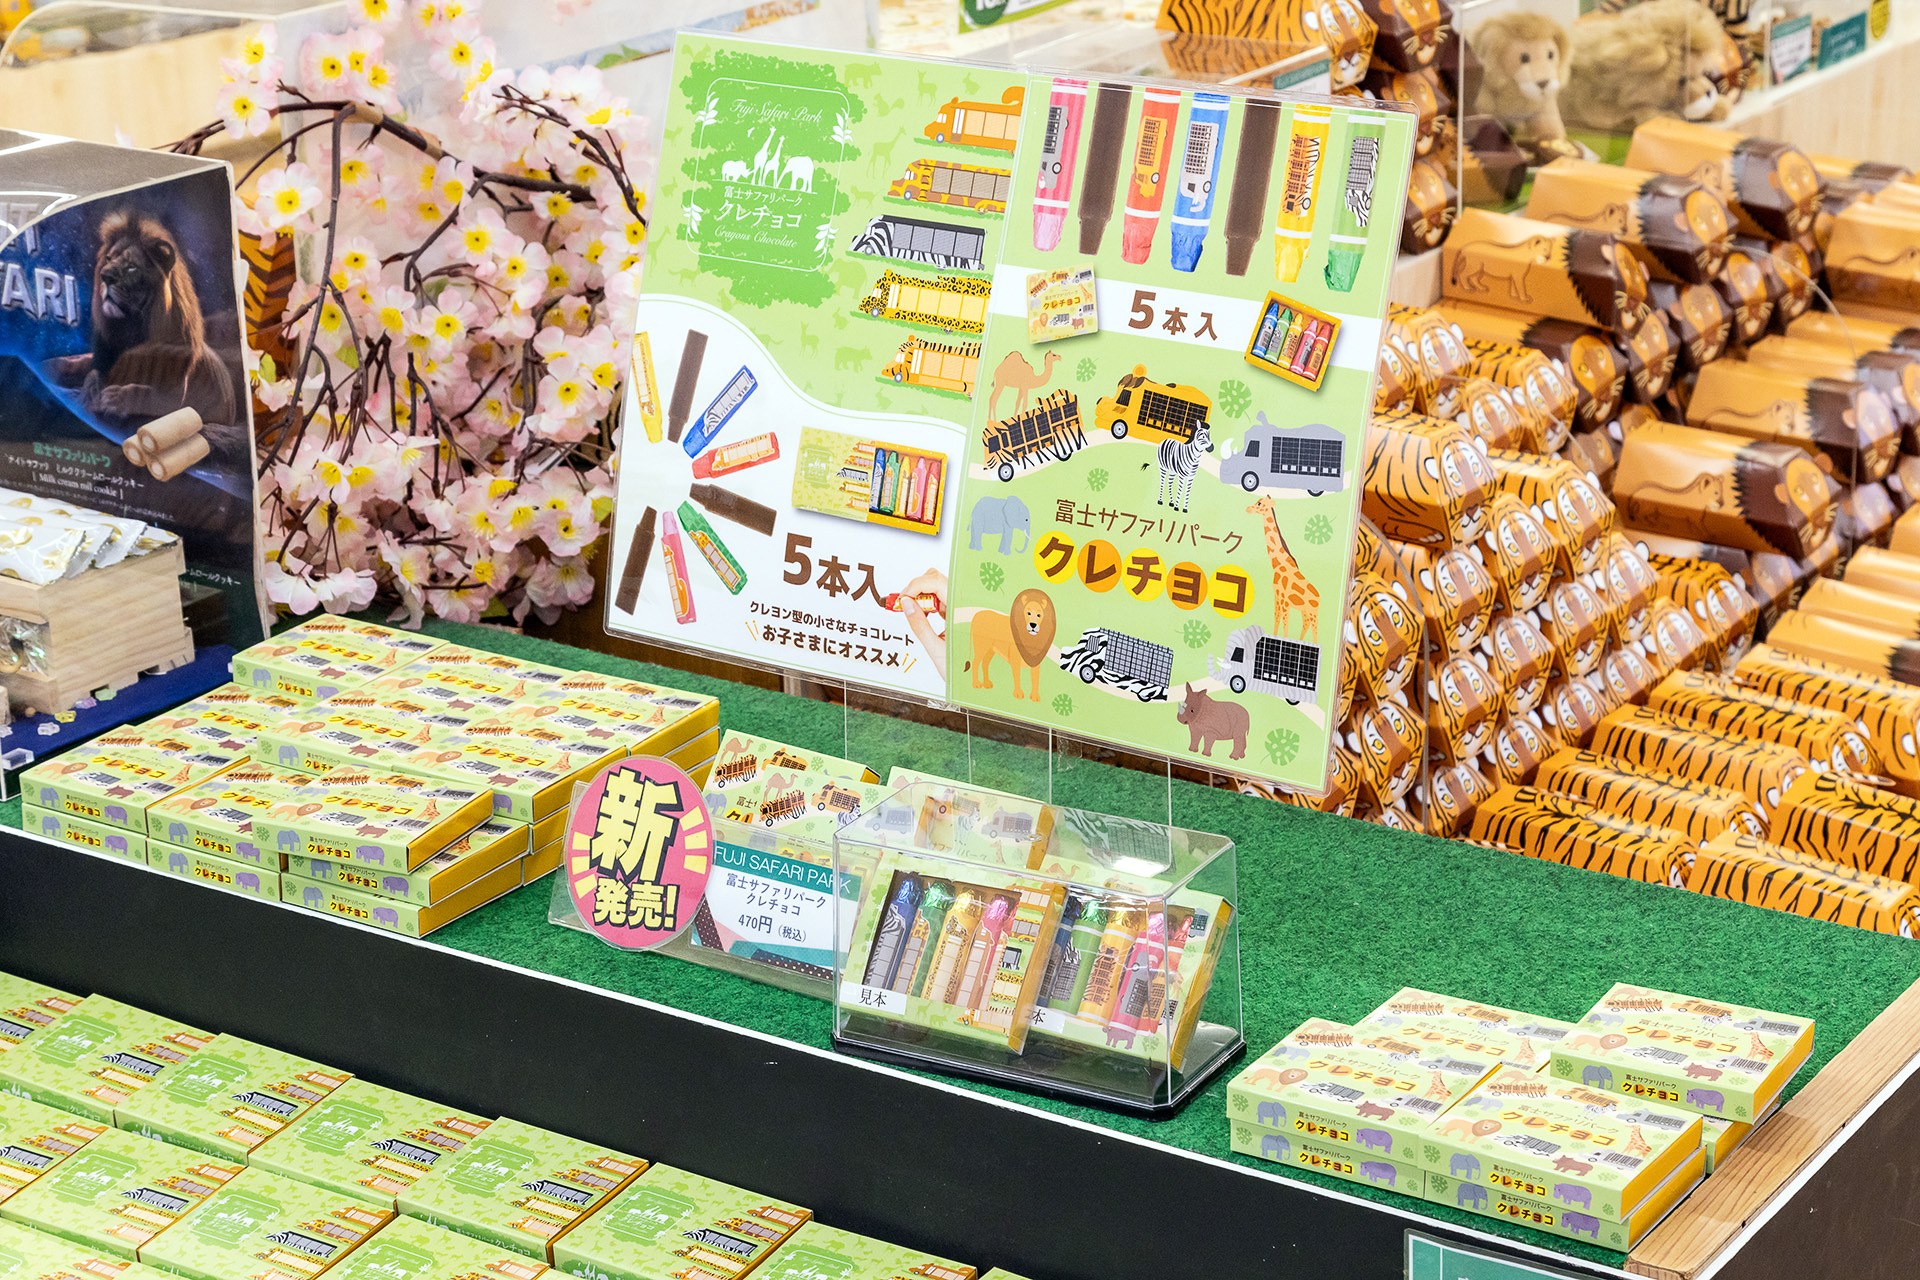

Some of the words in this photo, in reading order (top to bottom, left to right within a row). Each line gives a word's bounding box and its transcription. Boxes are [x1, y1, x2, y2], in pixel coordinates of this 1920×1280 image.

[730, 99, 754, 118] Fuji
[756, 101, 789, 120] Safari
[791, 107, 823, 123] Park
[724, 185, 803, 207] 富士サファリパーク
[716, 200, 802, 229] クレチョコ
[714, 225, 750, 242] Crayons
[753, 231, 798, 248] Chocolate
[0, 262, 79, 327] ARI
[1043, 296, 1081, 311] クレチョコ
[1128, 289, 1218, 341] 5本入
[1055, 498, 1243, 554] 富士サファリパーク
[783, 532, 886, 608] 5本入
[1039, 536, 1247, 613] クレチョコ
[750, 601, 914, 647] クレヨン型の小さなチョコレート
[762, 624, 900, 668] お子さまにオススメ
[278, 681, 313, 697] クレチョコ
[201, 712, 268, 731] クレチョ
[305, 760, 333, 771] クレチ
[65, 801, 100, 817] クレチョコ
[221, 792, 270, 809] クレチ
[324, 796, 413, 815] クレチョコ
[590, 766, 683, 884] 新
[66, 830, 101, 846] クレチョコ
[194, 837, 231, 853] クレチョコ
[308, 844, 351, 859] クレチョコ
[194, 867, 231, 884] クレチョコ
[714, 845, 746, 867] FUJI
[749, 854, 804, 882] SAFARI
[807, 869, 851, 894] PARK
[338, 872, 378, 889] クレチョコ
[726, 872, 826, 909] 富士サファリパーク
[330, 902, 369, 919] クレチョコ
[746, 893, 801, 916] クレチョコ
[738, 914, 773, 934] 470円
[859, 988, 887, 1008] 見本
[1402, 1028, 1506, 1056] クレチョコ
[1626, 1026, 1737, 1053] クレチョコ
[1309, 1060, 1417, 1091] クレチョコ
[1626, 1074, 1676, 1089] 富士サファリパーク
[1623, 1082, 1679, 1102] クレチョコ
[1299, 1111, 1347, 1128] 富士サファリパーク
[1503, 1111, 1615, 1146] クレチョコ
[1295, 1120, 1349, 1141] クレチョコ
[1302, 1144, 1351, 1161] 富士サファリパーク
[1299, 1152, 1353, 1175] クレチョコ
[1493, 1164, 1544, 1183] 富士サファリパーク
[1490, 1173, 1546, 1197] クレチョコ
[1501, 1194, 1552, 1212] 富士サファリパーク
[1497, 1203, 1554, 1226] クレチョコ
